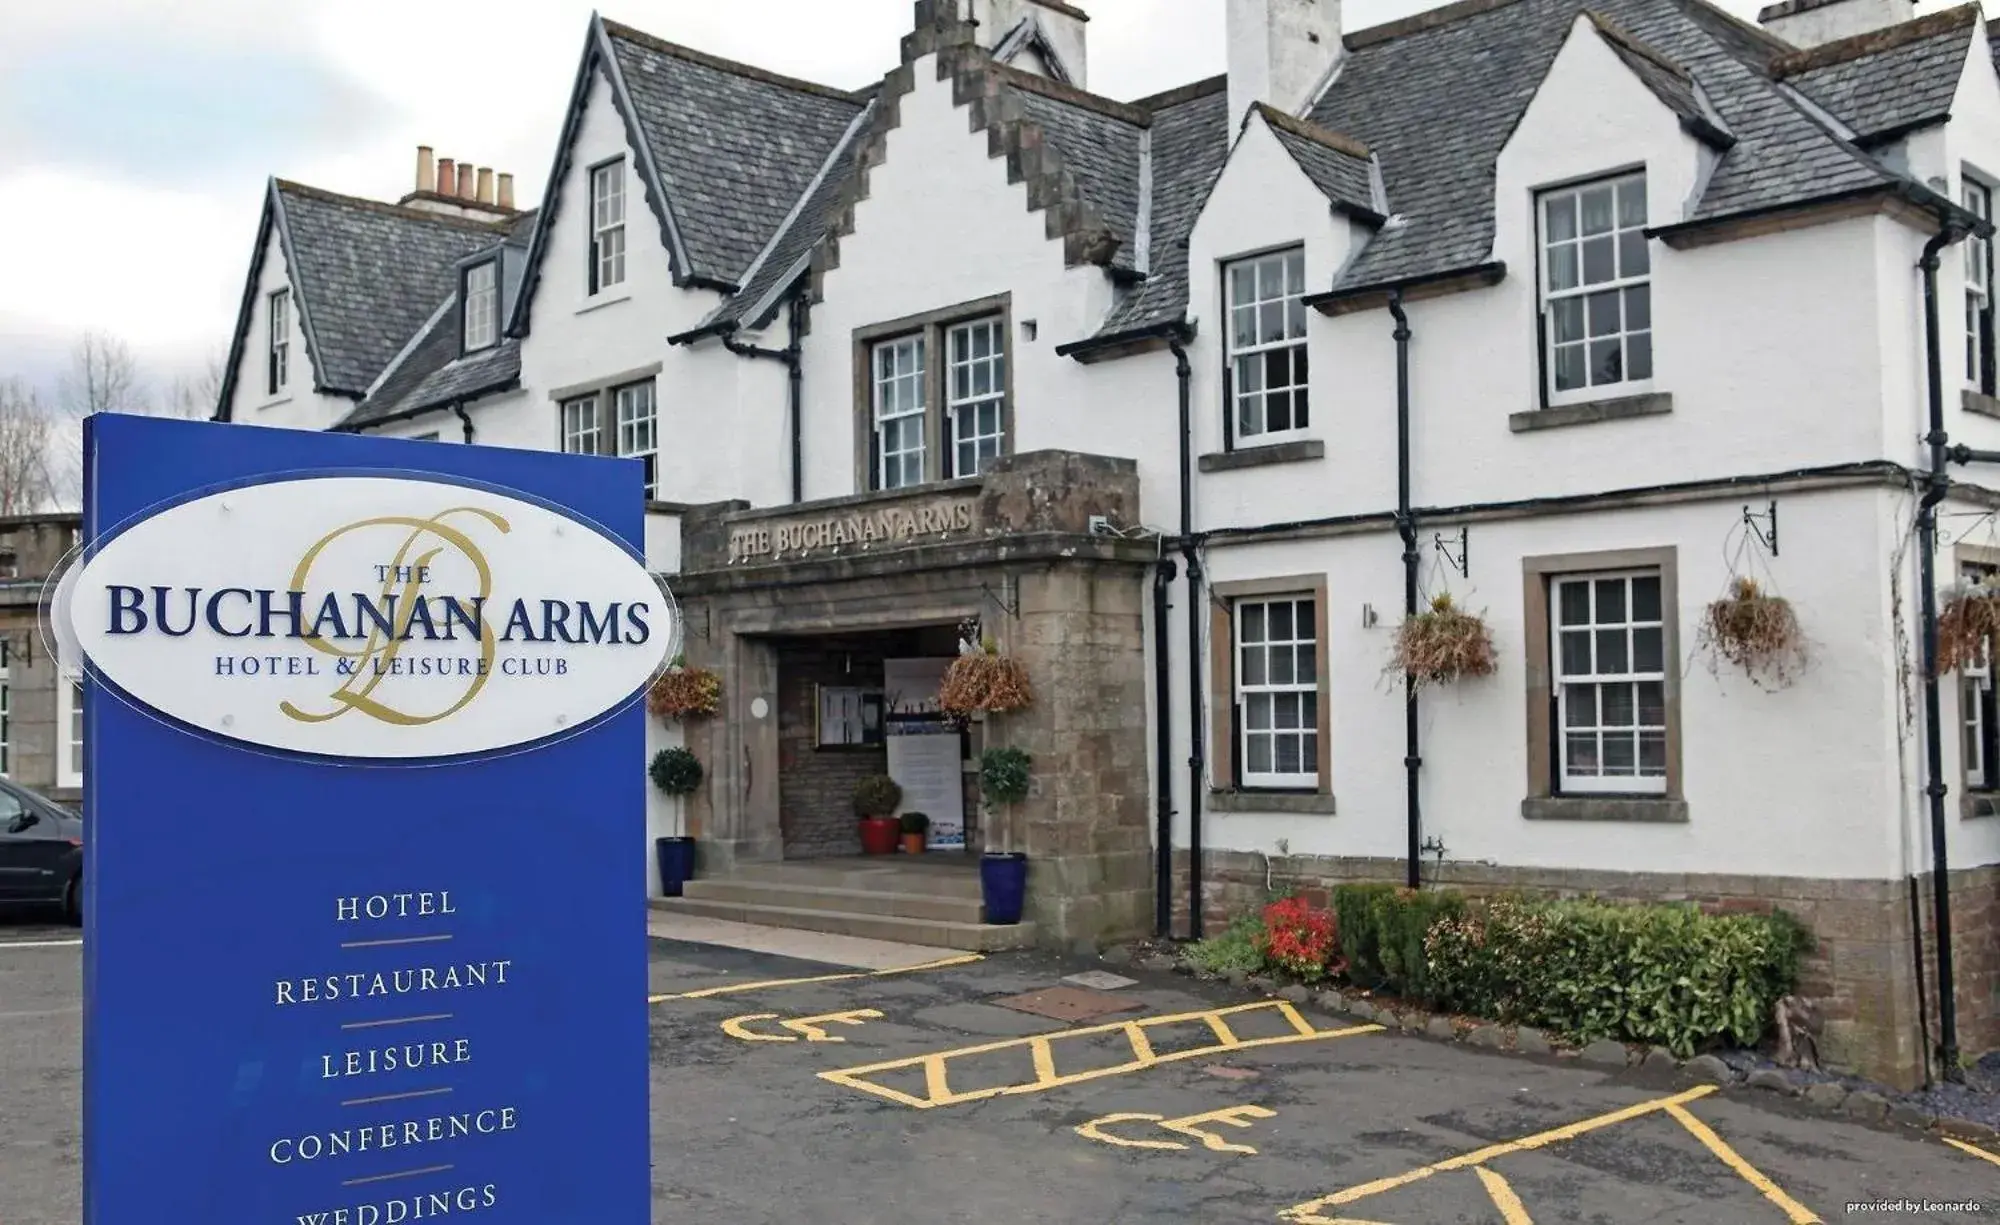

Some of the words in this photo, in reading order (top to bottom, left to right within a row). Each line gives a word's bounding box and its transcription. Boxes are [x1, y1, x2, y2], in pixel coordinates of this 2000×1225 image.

[730, 531, 770, 557] THE
[777, 510, 897, 551] BUCHANAN
[901, 503, 971, 537] ARMS
[374, 564, 432, 584] THE
[104, 585, 486, 642] BUCHANAN
[499, 598, 650, 645] ARMS
[215, 655, 320, 676] HOTEL
[336, 655, 358, 676] &
[373, 656, 488, 676] LEISURE
[502, 656, 569, 676] CLUB
[336, 891, 457, 922] HOTEL
[274, 960, 512, 1005] RESTAURANT
[321, 1039, 472, 1079] LEISURE
[269, 1106, 518, 1164] CONFERENCE
